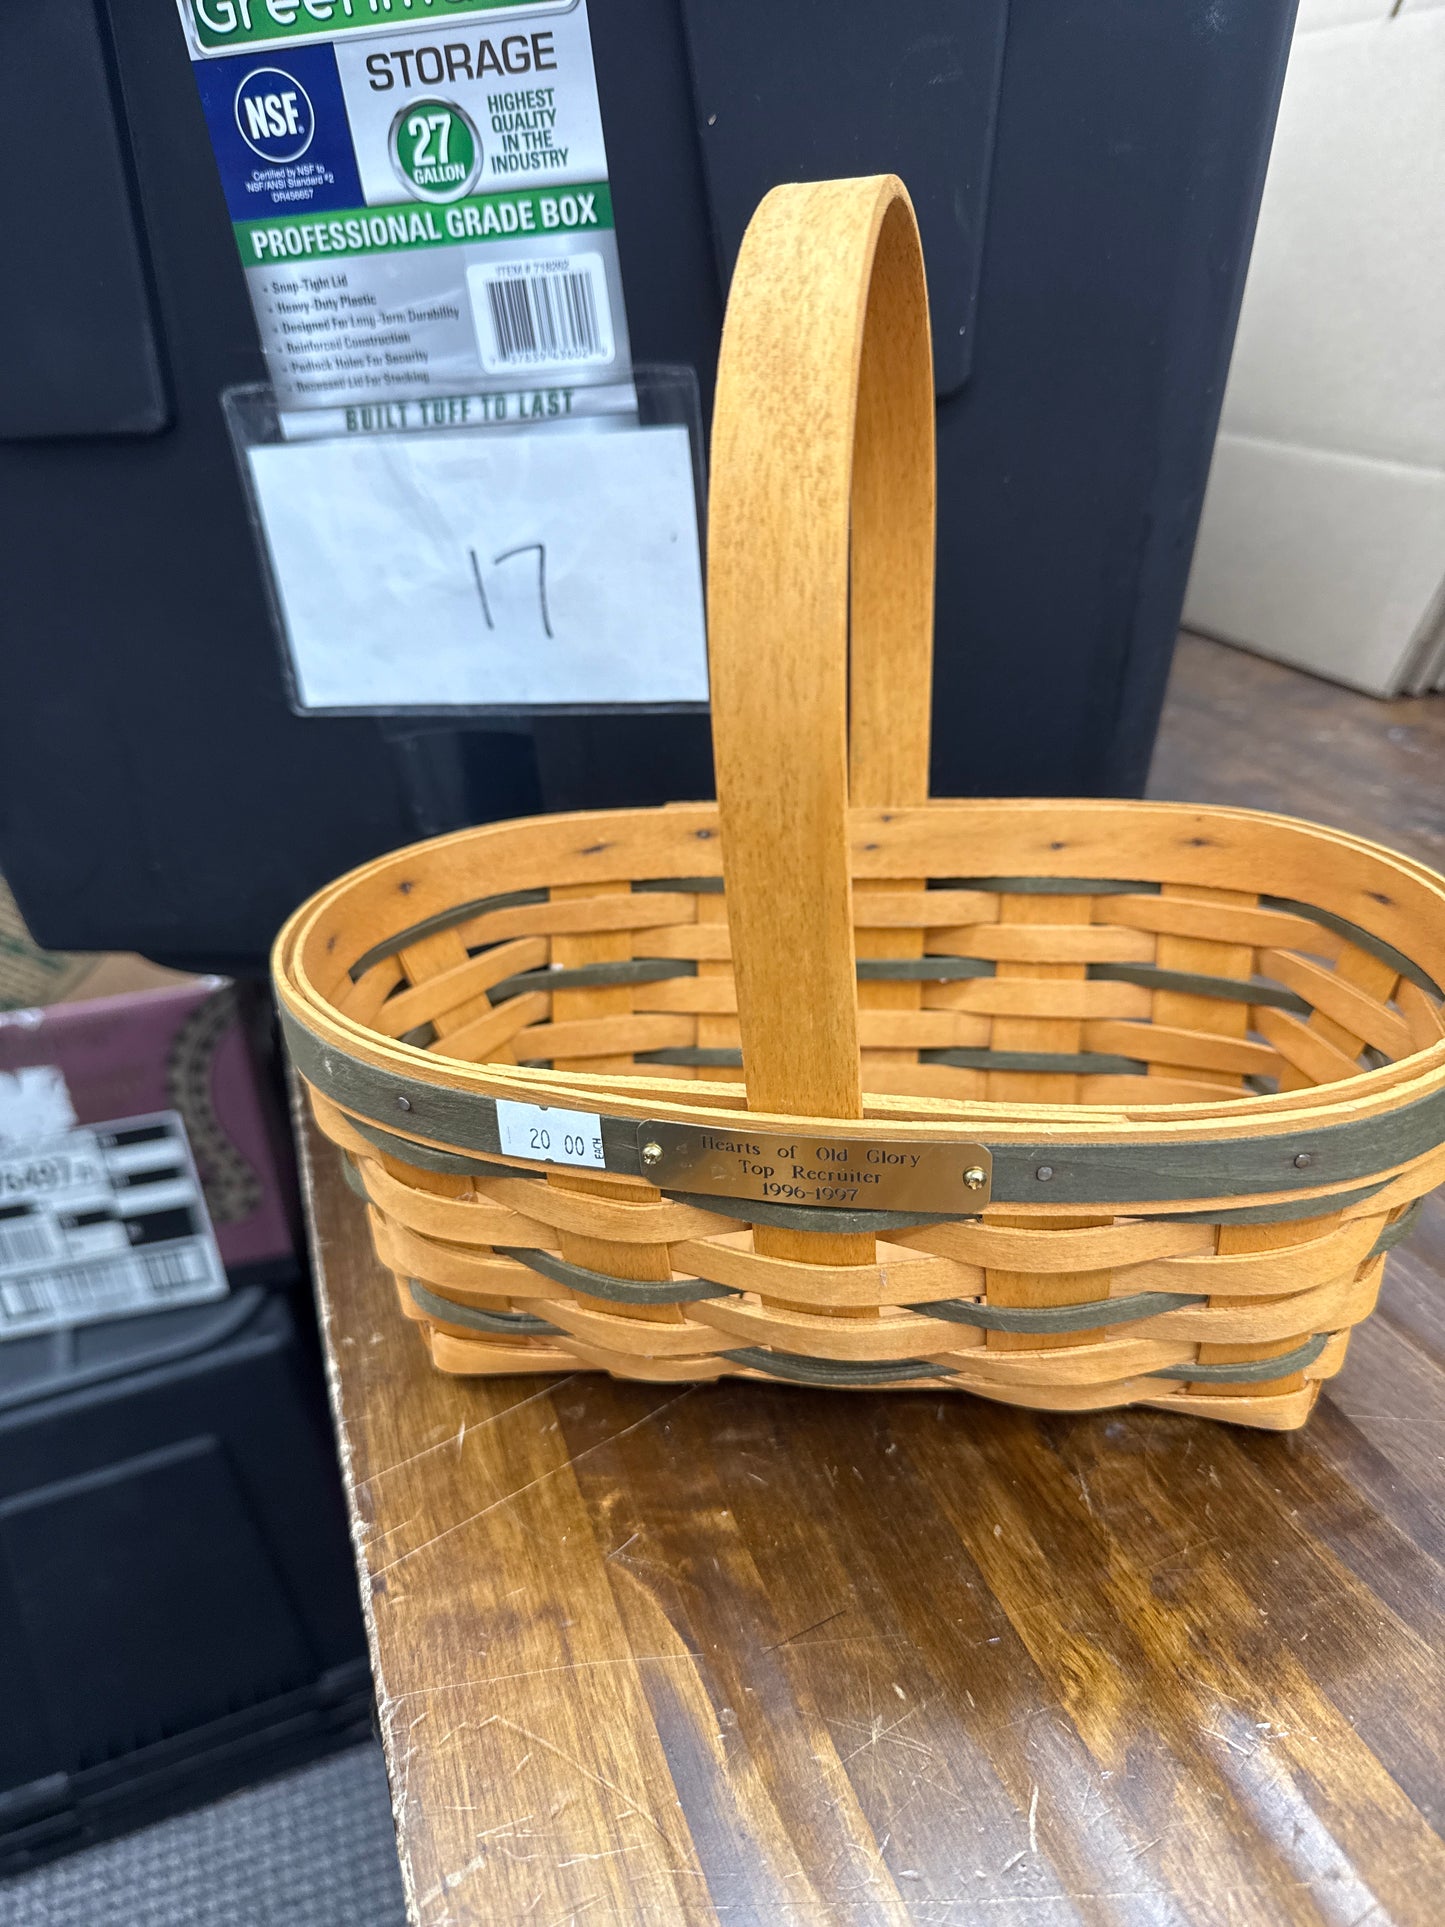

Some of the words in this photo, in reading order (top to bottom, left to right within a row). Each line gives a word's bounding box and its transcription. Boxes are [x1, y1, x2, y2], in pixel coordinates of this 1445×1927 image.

[365, 32, 558, 92] STORAGE
[487, 87, 555, 114] HIGHEST
[244, 92, 298, 139] NSF
[491, 108, 557, 134] QUALITY
[408, 113, 452, 167] 27
[502, 132, 520, 153] IN
[522, 129, 553, 150] THE
[251, 167, 286, 182] Certified
[286, 166, 296, 180] by
[296, 162, 315, 176] NSF
[412, 161, 466, 184] GALLON
[491, 148, 569, 175] INDUSTRY
[250, 210, 442, 260] PROFESSIONAL
[445, 198, 536, 239] GRADE
[539, 192, 598, 228] BOX
[331, 273, 349, 289] Lid
[340, 294, 377, 310] Plastic
[344, 401, 409, 432] BUILT
[418, 396, 472, 427] TUFF
[481, 392, 508, 421] TO
[518, 387, 574, 418] LAST
[468, 542, 554, 640] 17
[529, 1128, 551, 1150] 20
[564, 1134, 585, 1157] 00
[702, 1135, 761, 1156] Hearts
[777, 1145, 798, 1159] of
[816, 1146, 848, 1162] Old
[866, 1148, 921, 1168] Glory
[738, 1159, 775, 1178] Top
[791, 1164, 882, 1184] Recruiter
[762, 1182, 859, 1201] 1996-1997
